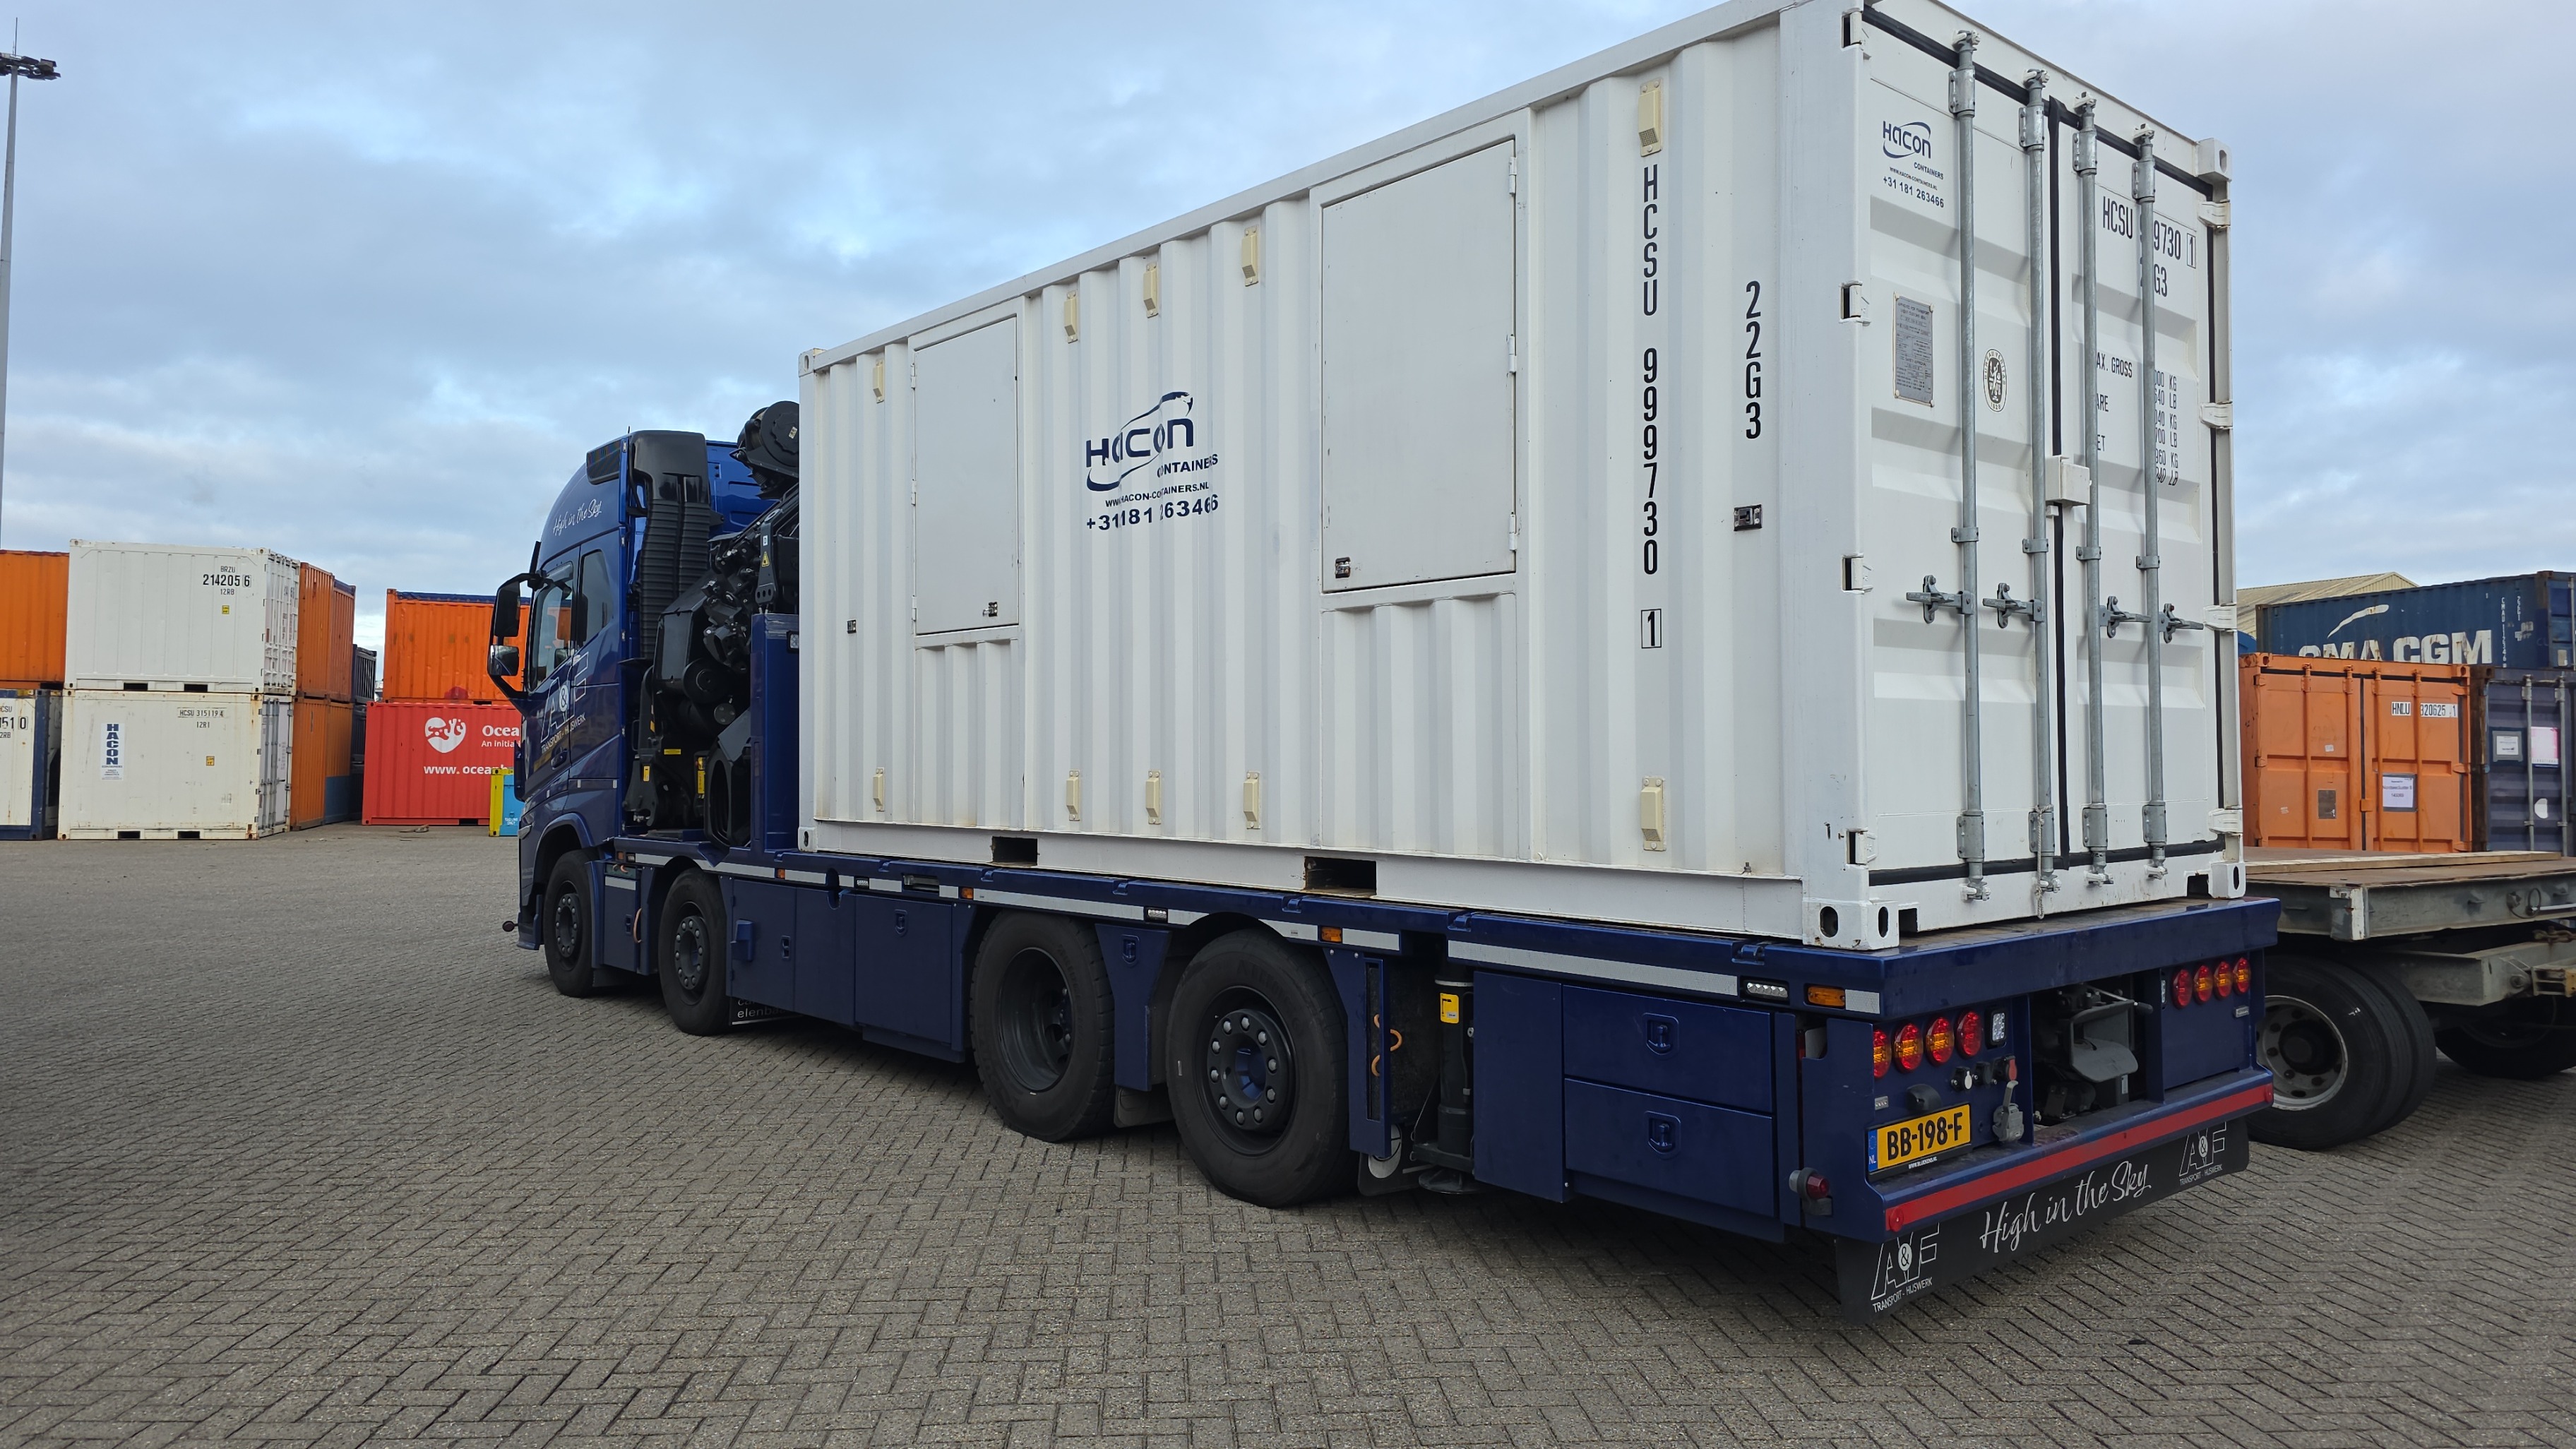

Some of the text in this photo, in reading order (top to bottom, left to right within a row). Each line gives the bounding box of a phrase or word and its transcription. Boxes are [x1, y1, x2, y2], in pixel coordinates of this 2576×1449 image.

[1914, 162, 1943, 180] CONTAINERS
[1883, 177, 1944, 208] +31 181 263466
[2103, 196, 2133, 239] HCSU
[1745, 281, 1761, 439] 22G3
[2096, 352, 2133, 378] AX. GROSS
[2169, 374, 2176, 392] KG
[1643, 164, 1658, 647] HCSU 999730 1
[2097, 393, 2109, 412] ARE
[2169, 392, 2176, 410] LB
[2169, 413, 2177, 430] KG
[2097, 434, 2106, 451] ET
[2170, 432, 2177, 448] LB
[2171, 452, 2178, 469] KG
[2168, 470, 2178, 487] LB
[1159, 494, 1218, 521] 263466
[553, 511, 568, 536] High
[568, 513, 576, 526] in
[576, 503, 588, 524] the
[203, 574, 250, 587] 214205 6
[2393, 629, 2492, 664] CGM
[2392, 703, 2410, 715] HNLU
[0, 717, 14, 729] 51
[482, 724, 520, 737] Ocea
[564, 712, 586, 735] HJSWERK
[106, 724, 119, 765] HACON
[1887, 1111, 1963, 1161] BB-198-F
[1868, 1155, 1877, 1165] NL
[1979, 1160, 2152, 1253] High in the Sky
[1872, 1289, 1902, 1313] TRANSPORT
